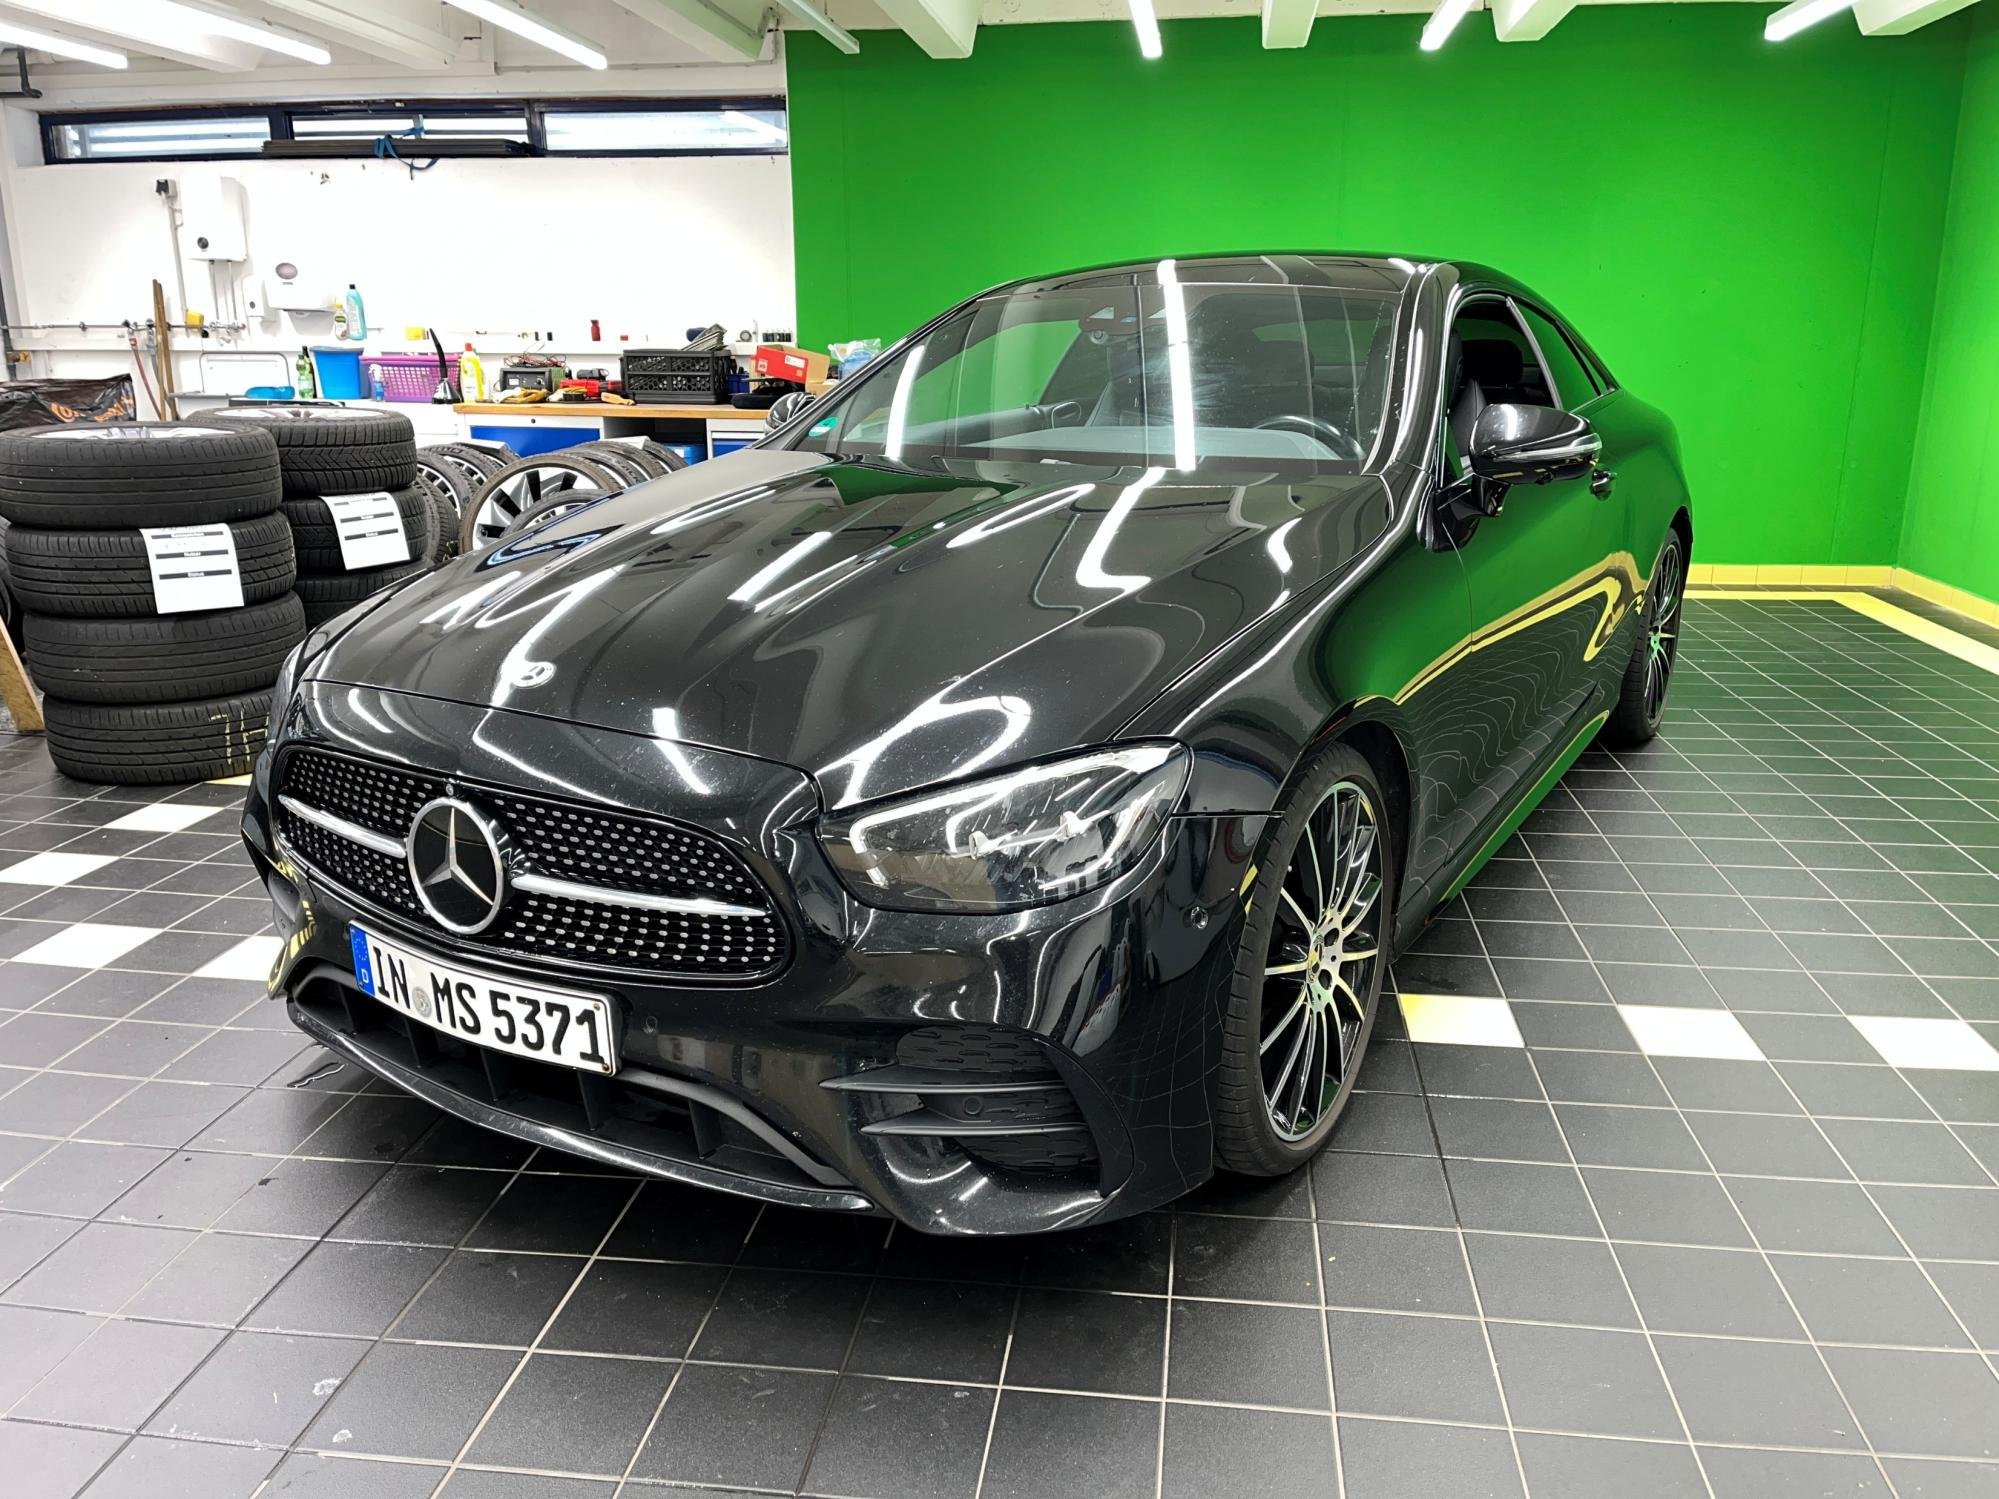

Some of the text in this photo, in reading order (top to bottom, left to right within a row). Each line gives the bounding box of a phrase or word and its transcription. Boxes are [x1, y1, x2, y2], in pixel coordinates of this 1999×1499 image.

[361, 968, 369, 984] D
[372, 946, 606, 1066] IN MS 5371
